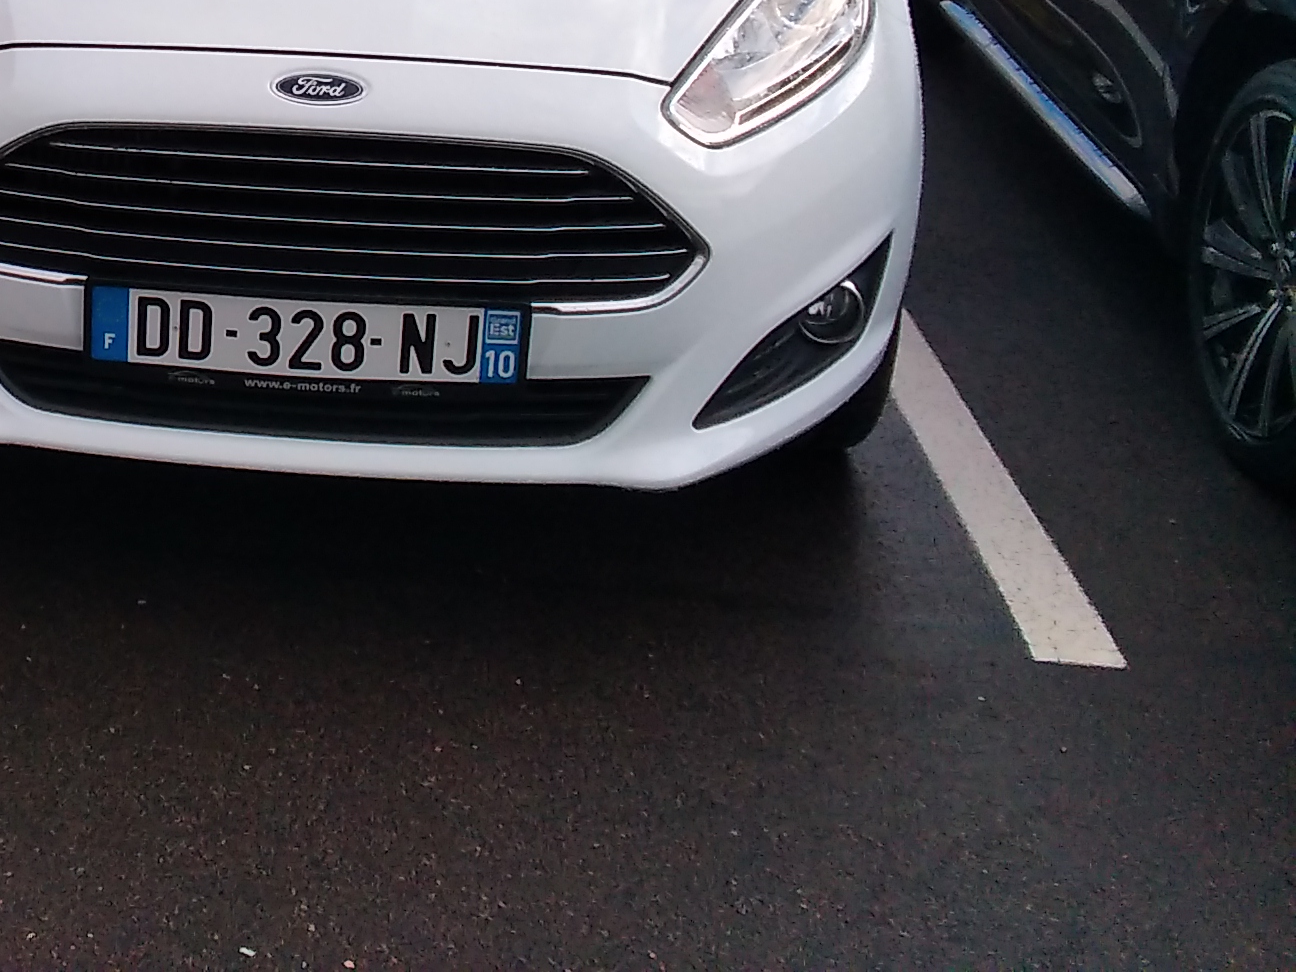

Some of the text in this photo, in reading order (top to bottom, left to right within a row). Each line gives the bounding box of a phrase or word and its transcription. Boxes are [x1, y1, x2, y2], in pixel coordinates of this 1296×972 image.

[292, 76, 346, 97] Ford
[490, 323, 515, 337] Est
[104, 332, 116, 349] F
[485, 349, 516, 379] 10
[244, 378, 362, 394] www.e-motors.fr
